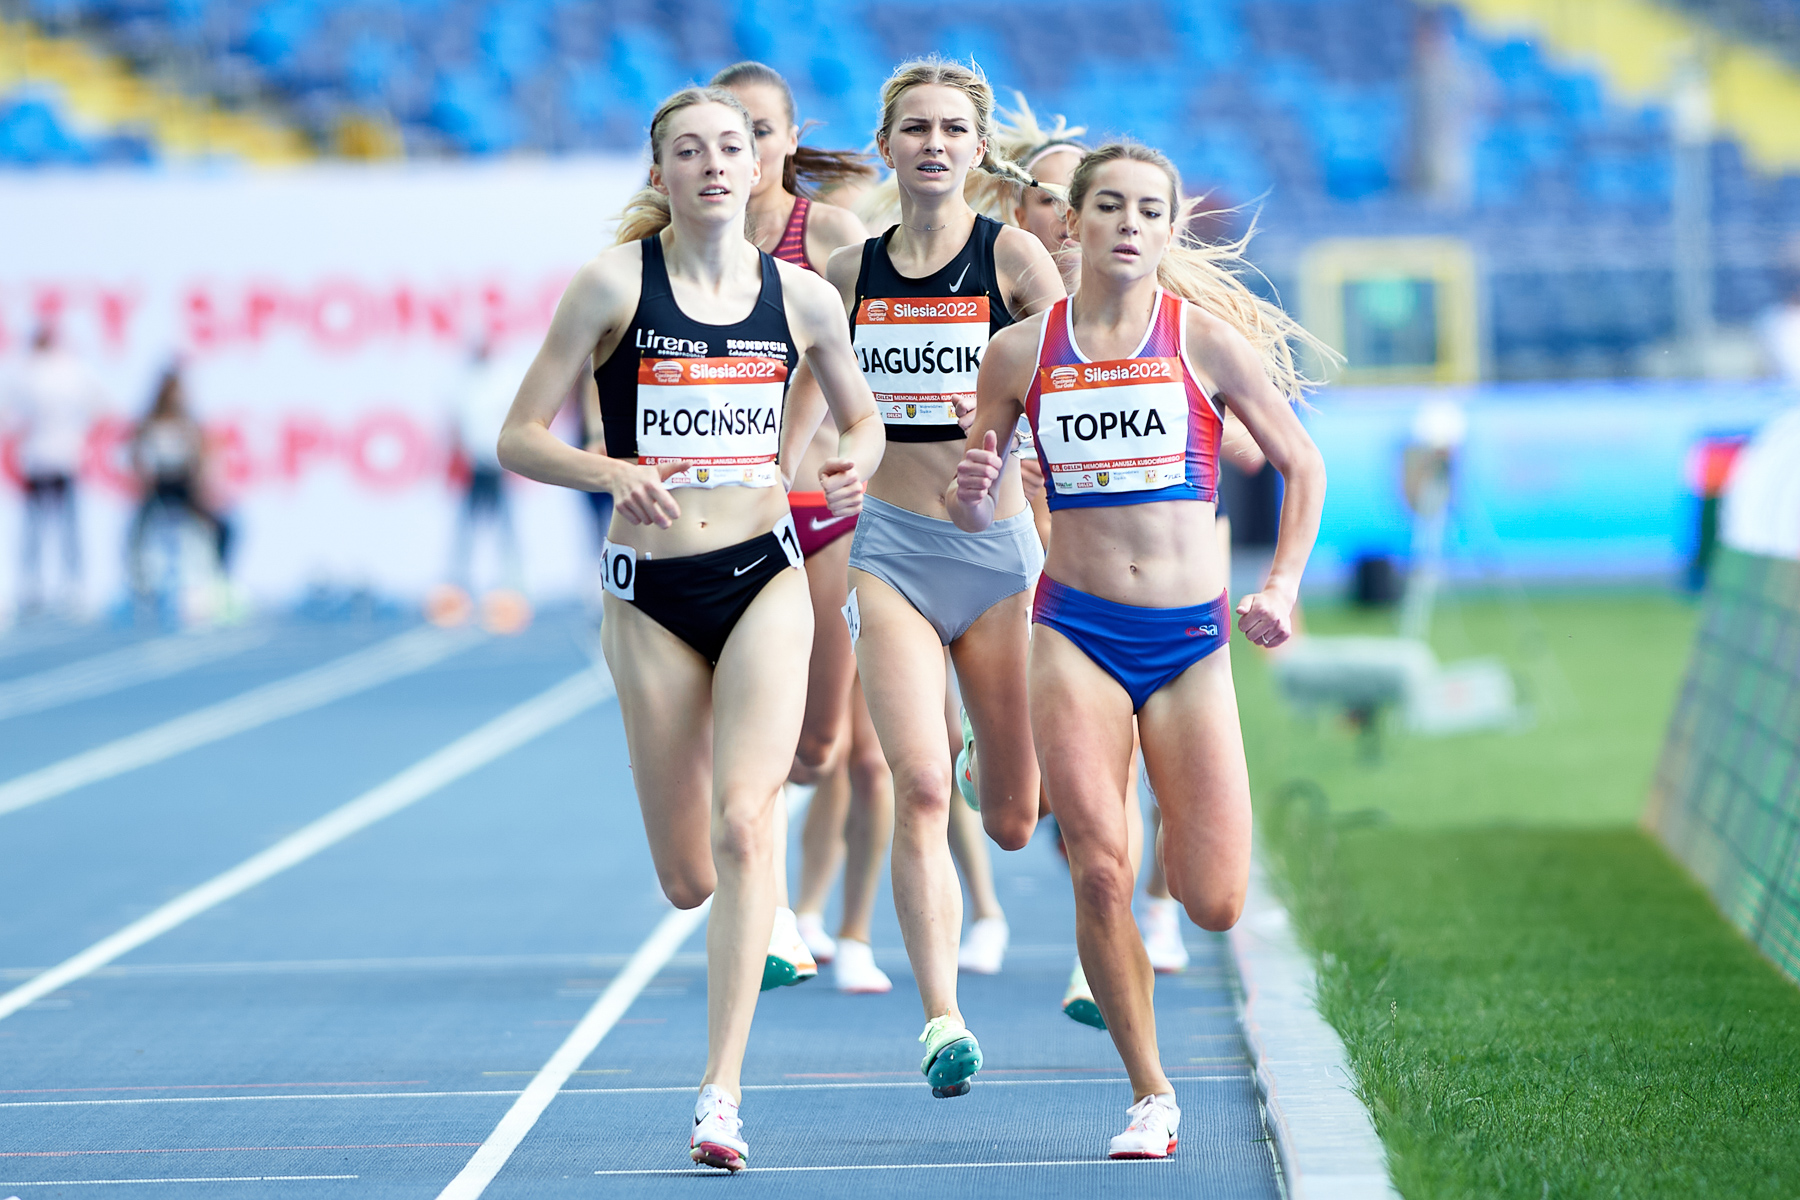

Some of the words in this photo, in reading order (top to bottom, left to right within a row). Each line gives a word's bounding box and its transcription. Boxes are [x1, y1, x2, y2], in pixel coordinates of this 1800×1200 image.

[893, 302, 977, 317] Silesia2022
[636, 328, 708, 355] Lirene
[689, 362, 775, 380] Silesia2022
[862, 341, 981, 374] JAGUŚCIK
[1084, 363, 1171, 382] Silesia2022
[643, 402, 776, 436] PŁOCIŃSKA
[1056, 408, 1166, 442] TOPKA
[1112, 460, 1136, 468] JANUSZA
[782, 525, 800, 558] 1
[602, 546, 633, 590] 10
